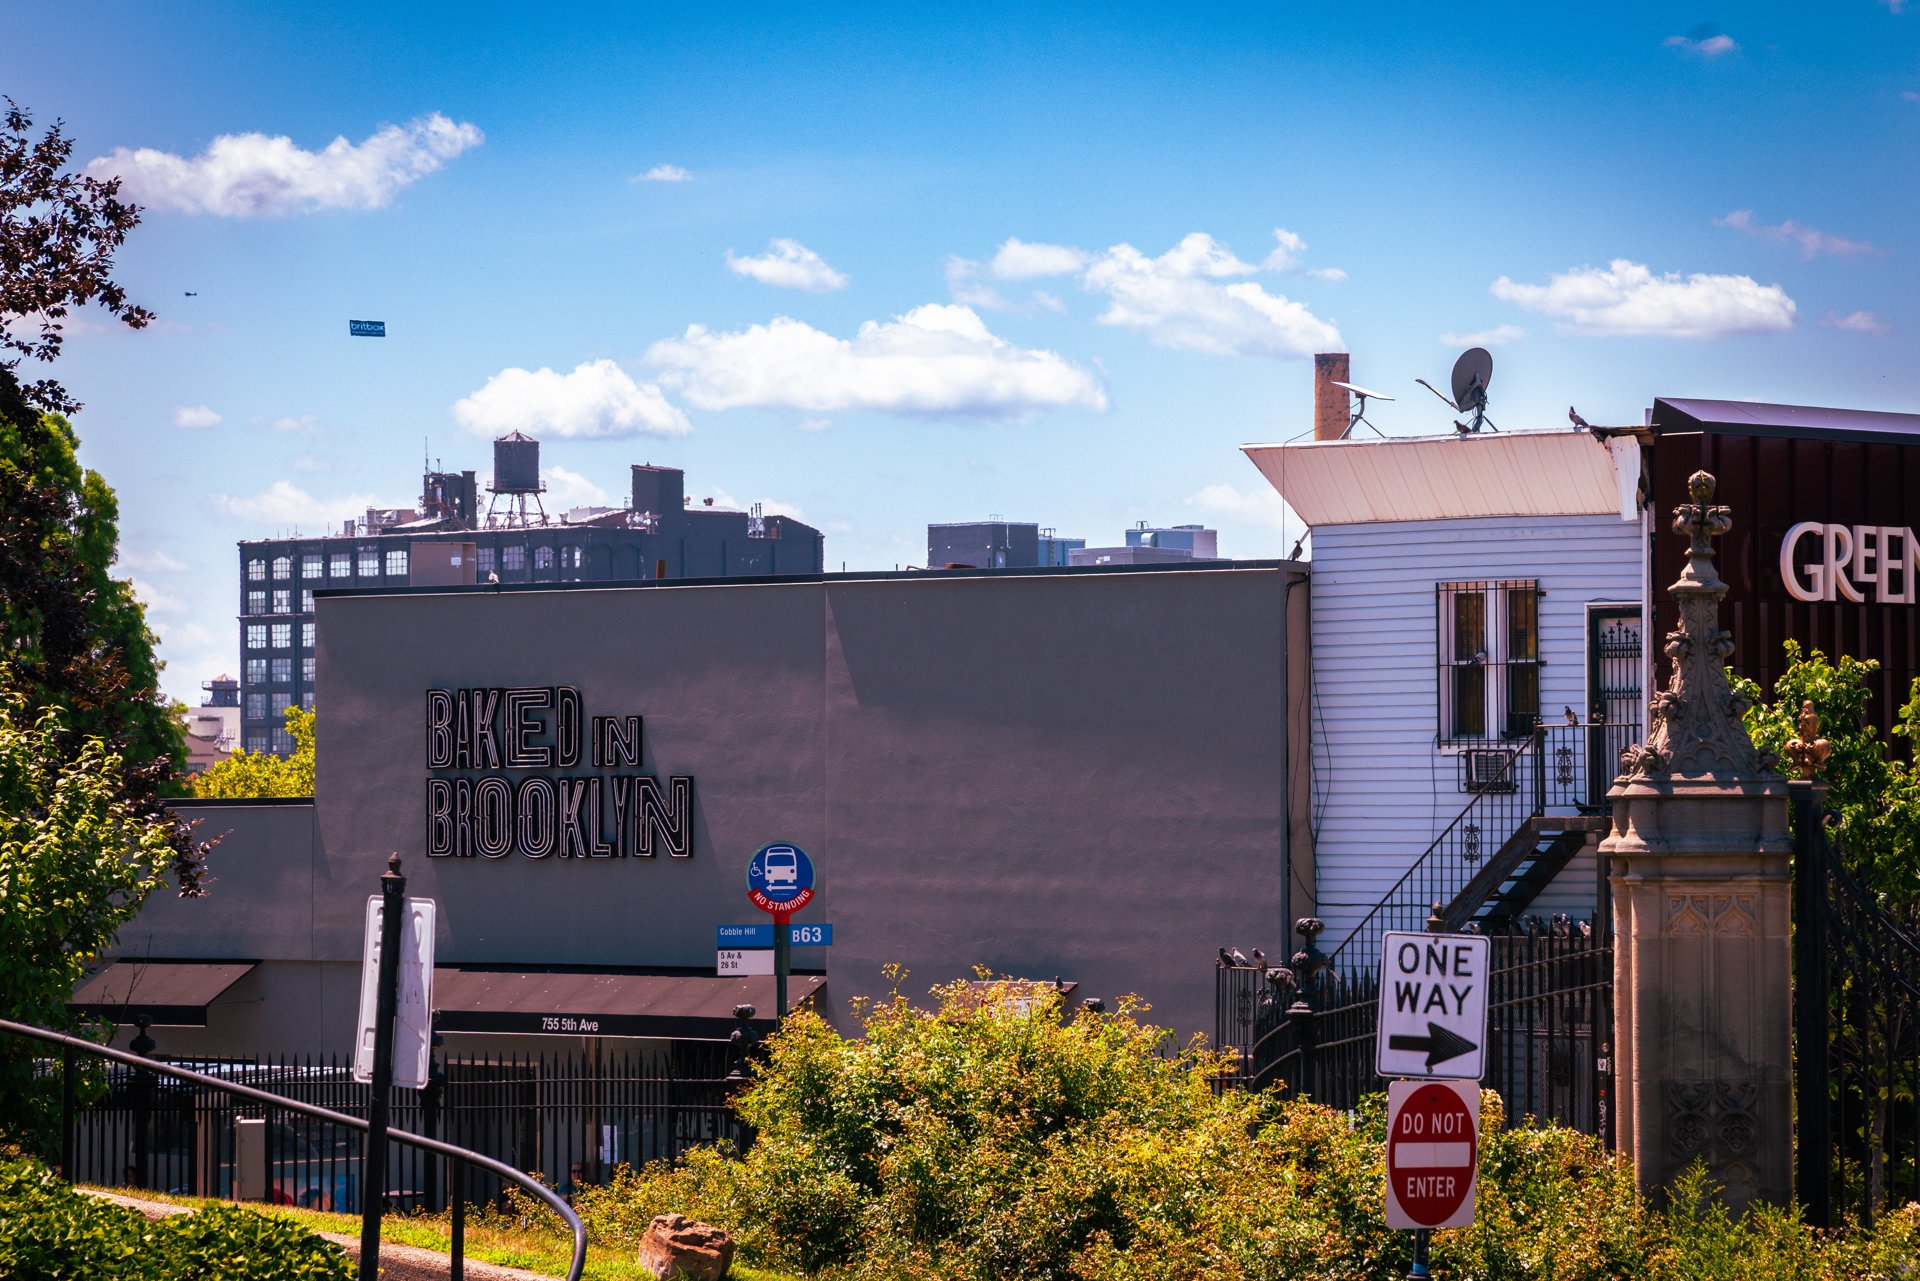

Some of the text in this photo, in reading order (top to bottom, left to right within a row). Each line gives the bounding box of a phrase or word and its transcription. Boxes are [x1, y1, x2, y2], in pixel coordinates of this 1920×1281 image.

[351, 321, 384, 331] britbox
[427, 683, 643, 769] BAKED IN
[427, 775, 694, 859] BROOKLYN
[753, 889, 810, 911] NO STANDING
[720, 927, 756, 936] Cobble Hill
[792, 926, 822, 943] B63
[720, 961, 738, 969] 26 St
[726, 952, 736, 960] Av
[1398, 942, 1473, 977] ONE
[1395, 981, 1473, 1016] WAY
[542, 1017, 599, 1031] 755 5th Ave
[1402, 1112, 1464, 1135] DO NOT
[1407, 1176, 1456, 1198] ENTER
